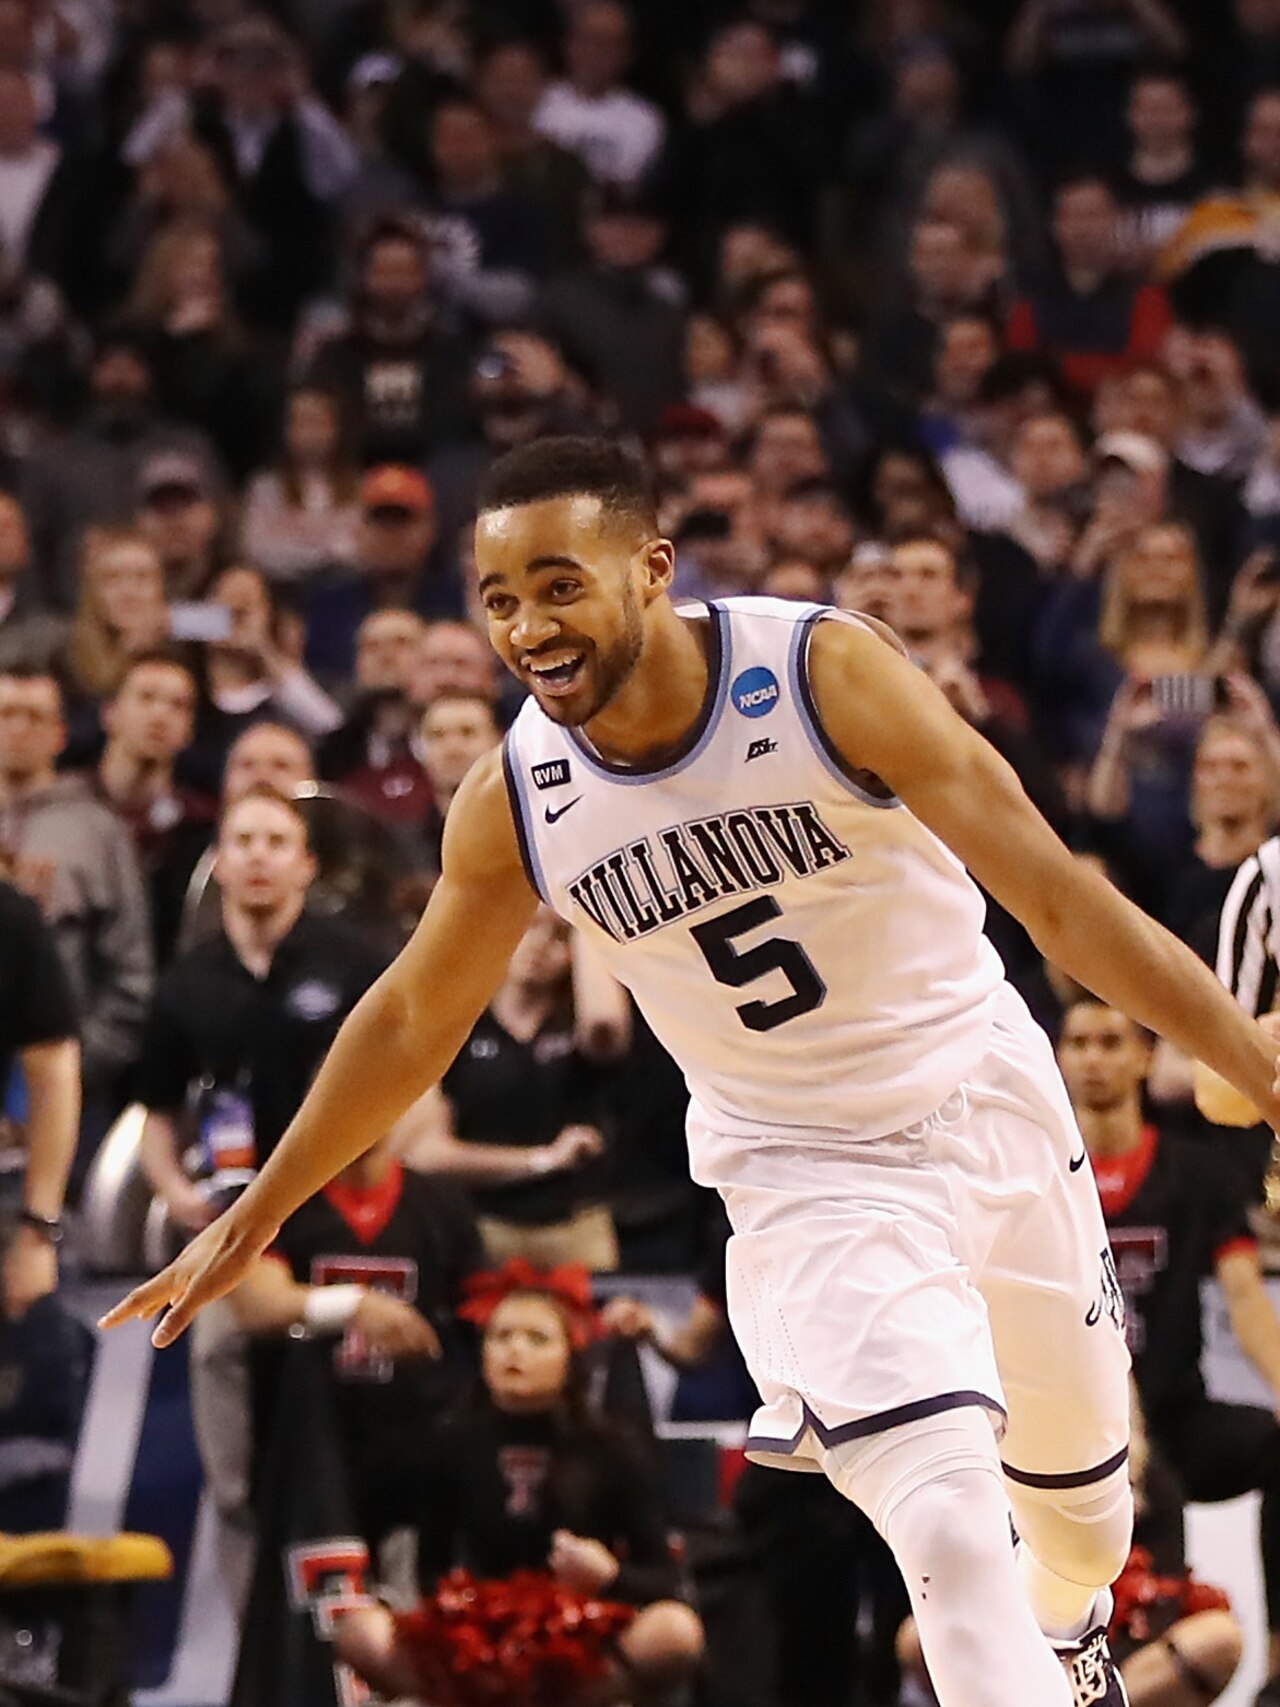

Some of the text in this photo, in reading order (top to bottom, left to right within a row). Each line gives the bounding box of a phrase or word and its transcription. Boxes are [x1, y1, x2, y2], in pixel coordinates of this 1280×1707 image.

[739, 684, 777, 709] NCAA
[533, 764, 564, 786] RVM
[566, 801, 853, 945] VILLANOVA
[689, 895, 828, 1032] 5
